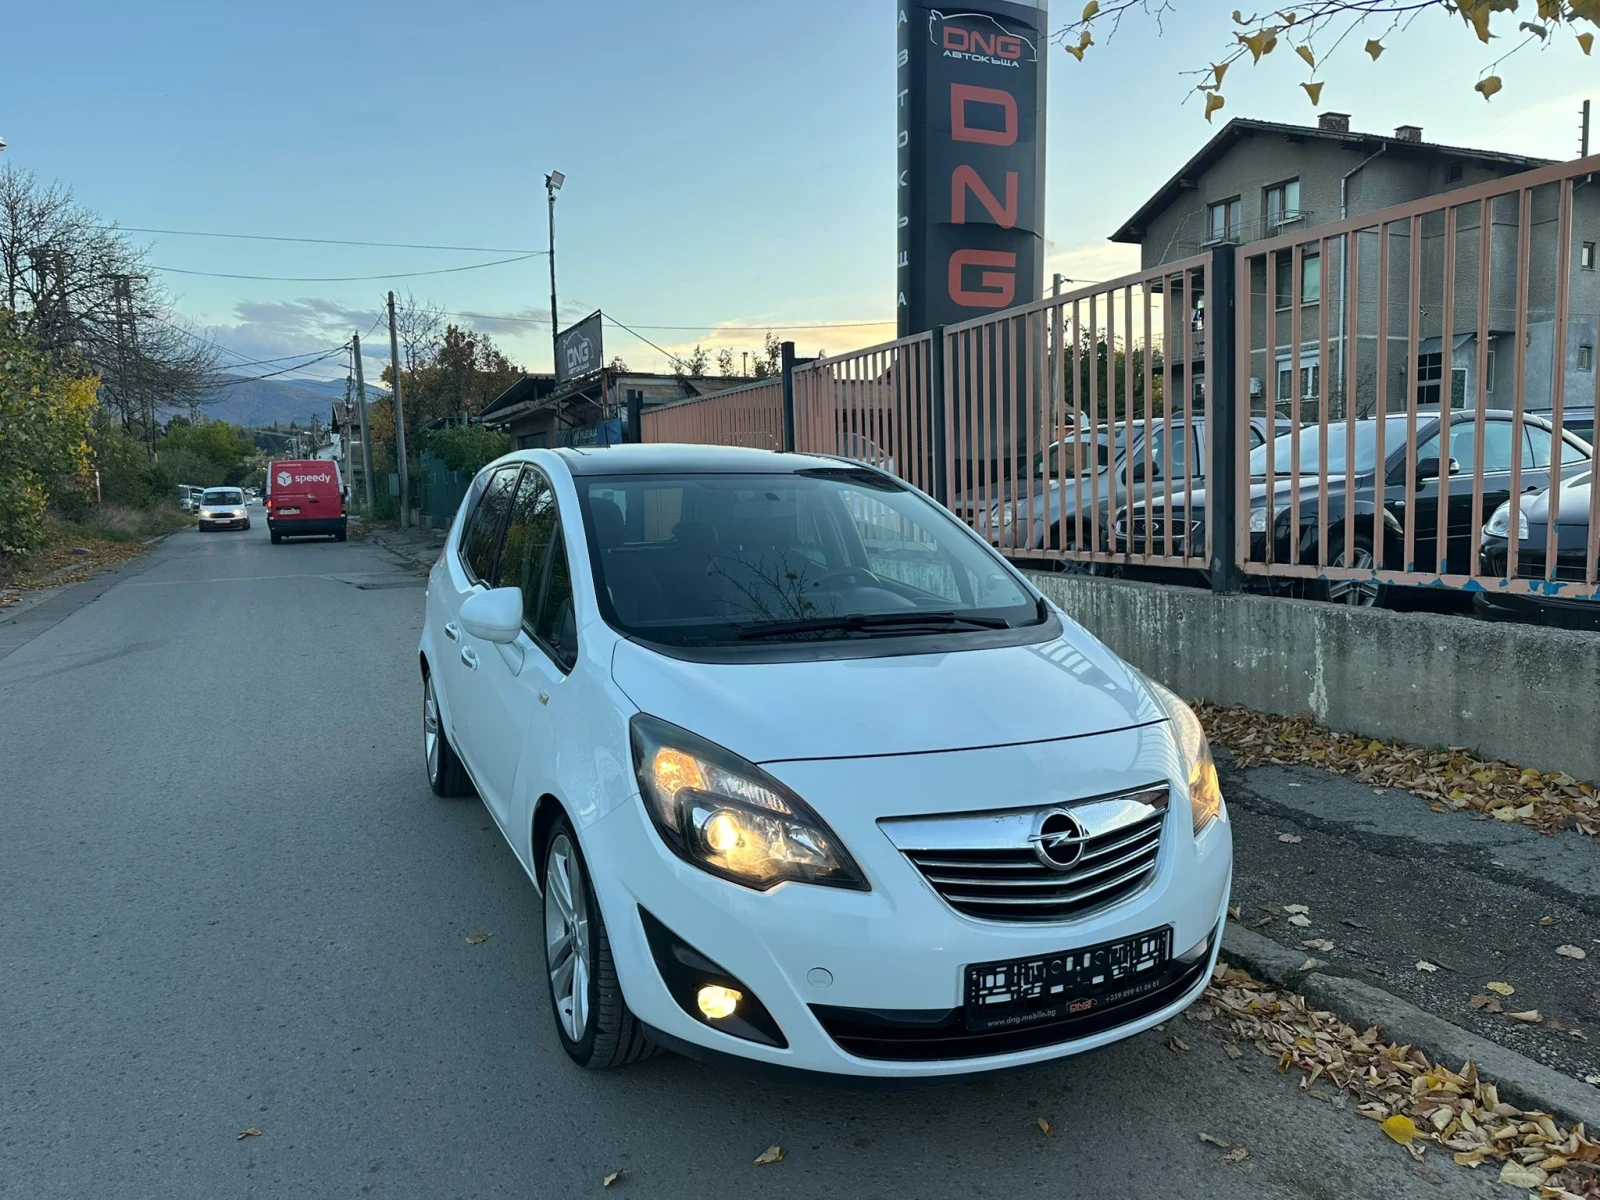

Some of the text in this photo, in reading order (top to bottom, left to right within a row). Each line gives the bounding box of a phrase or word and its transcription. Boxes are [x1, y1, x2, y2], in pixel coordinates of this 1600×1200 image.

[943, 26, 1021, 59] DNG
[943, 50, 1019, 68] АВТОКЪЩА
[948, 82, 1018, 308] DNG
[567, 341, 589, 369] DNG
[295, 472, 331, 484] speedy
[987, 1009, 1056, 1027] www.dng.mobile.bg
